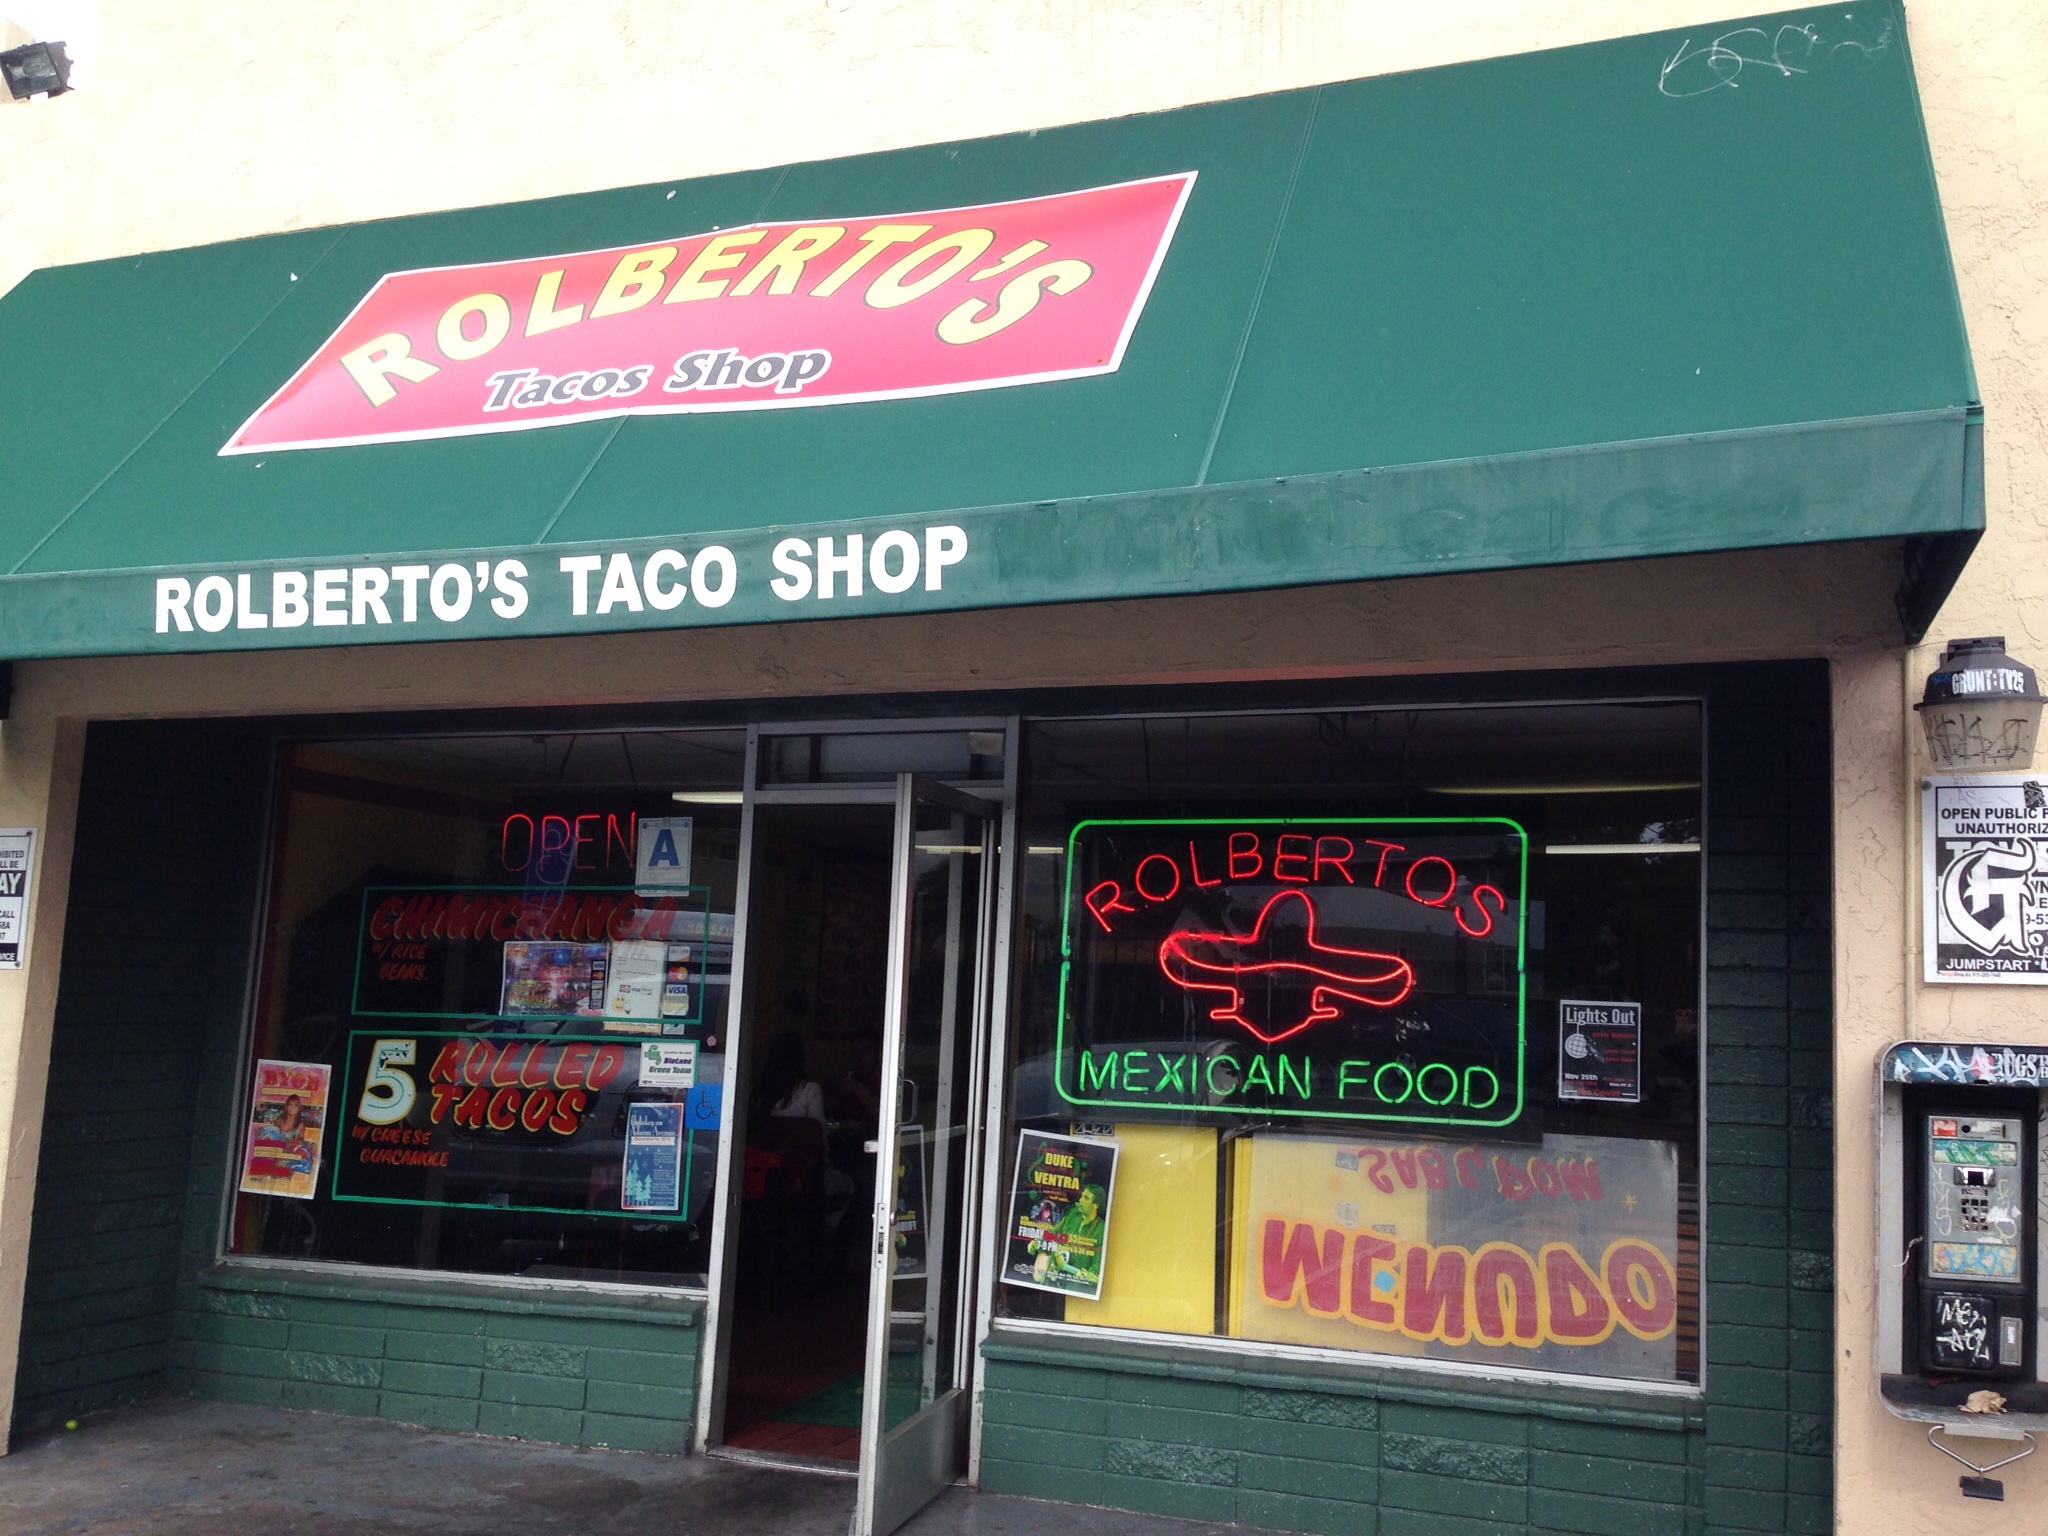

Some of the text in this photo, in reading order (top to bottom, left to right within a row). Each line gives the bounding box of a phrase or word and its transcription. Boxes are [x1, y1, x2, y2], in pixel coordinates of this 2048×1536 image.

[340, 223, 1094, 407] ROLBERTO'S
[484, 349, 831, 411] Tacos Shop
[155, 525, 968, 634] ROLBERTO'S TACO SHOP
[1941, 807, 1980, 819] OPEN
[1984, 808, 2037, 820] PUBLIC
[501, 811, 636, 872] OPEN
[648, 828, 679, 867] A
[370, 894, 680, 941] CHIMICHANGA
[391, 943, 429, 960] RICE
[1945, 958, 2031, 970] JUMPSTART
[668, 986, 687, 994] VISA
[1566, 1007, 1636, 1026] Lights Out
[357, 1039, 626, 1125] 5 ROLLED
[1079, 1050, 1499, 1108] MEXICAN FOOD
[429, 1083, 588, 1136] TACOS
[371, 1127, 432, 1145] CHEESE
[360, 1147, 450, 1167] GUACAMOLE
[1045, 1152, 1074, 1168] DUKE
[1034, 1171, 1080, 1190] VENTRA
[1018, 1226, 1044, 1240] FRIDAY
